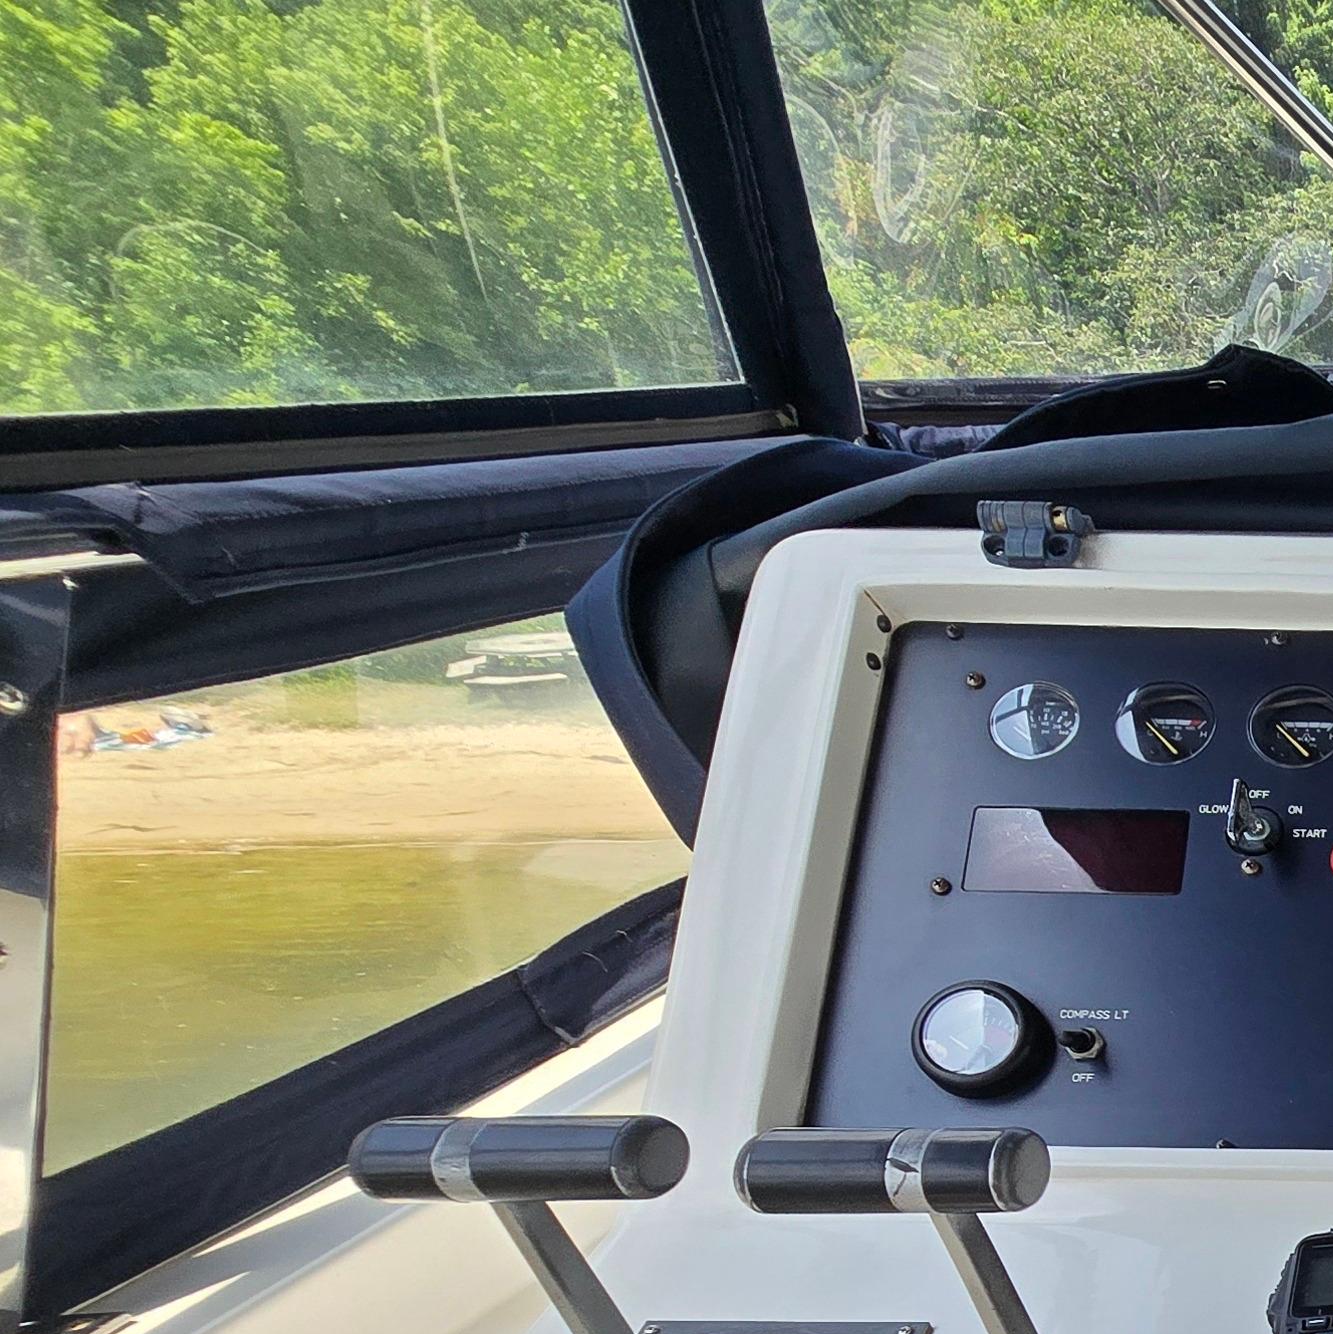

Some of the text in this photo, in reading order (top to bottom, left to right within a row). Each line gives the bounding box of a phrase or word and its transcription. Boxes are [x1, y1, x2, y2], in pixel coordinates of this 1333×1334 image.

[1248, 789, 1271, 799] OFF
[1198, 804, 1230, 814] GLOW
[1287, 805, 1303, 815] ON
[1292, 828, 1328, 838] START
[1059, 1010, 1130, 1020] COMPASS LT
[1071, 1073, 1096, 1083] OFF
